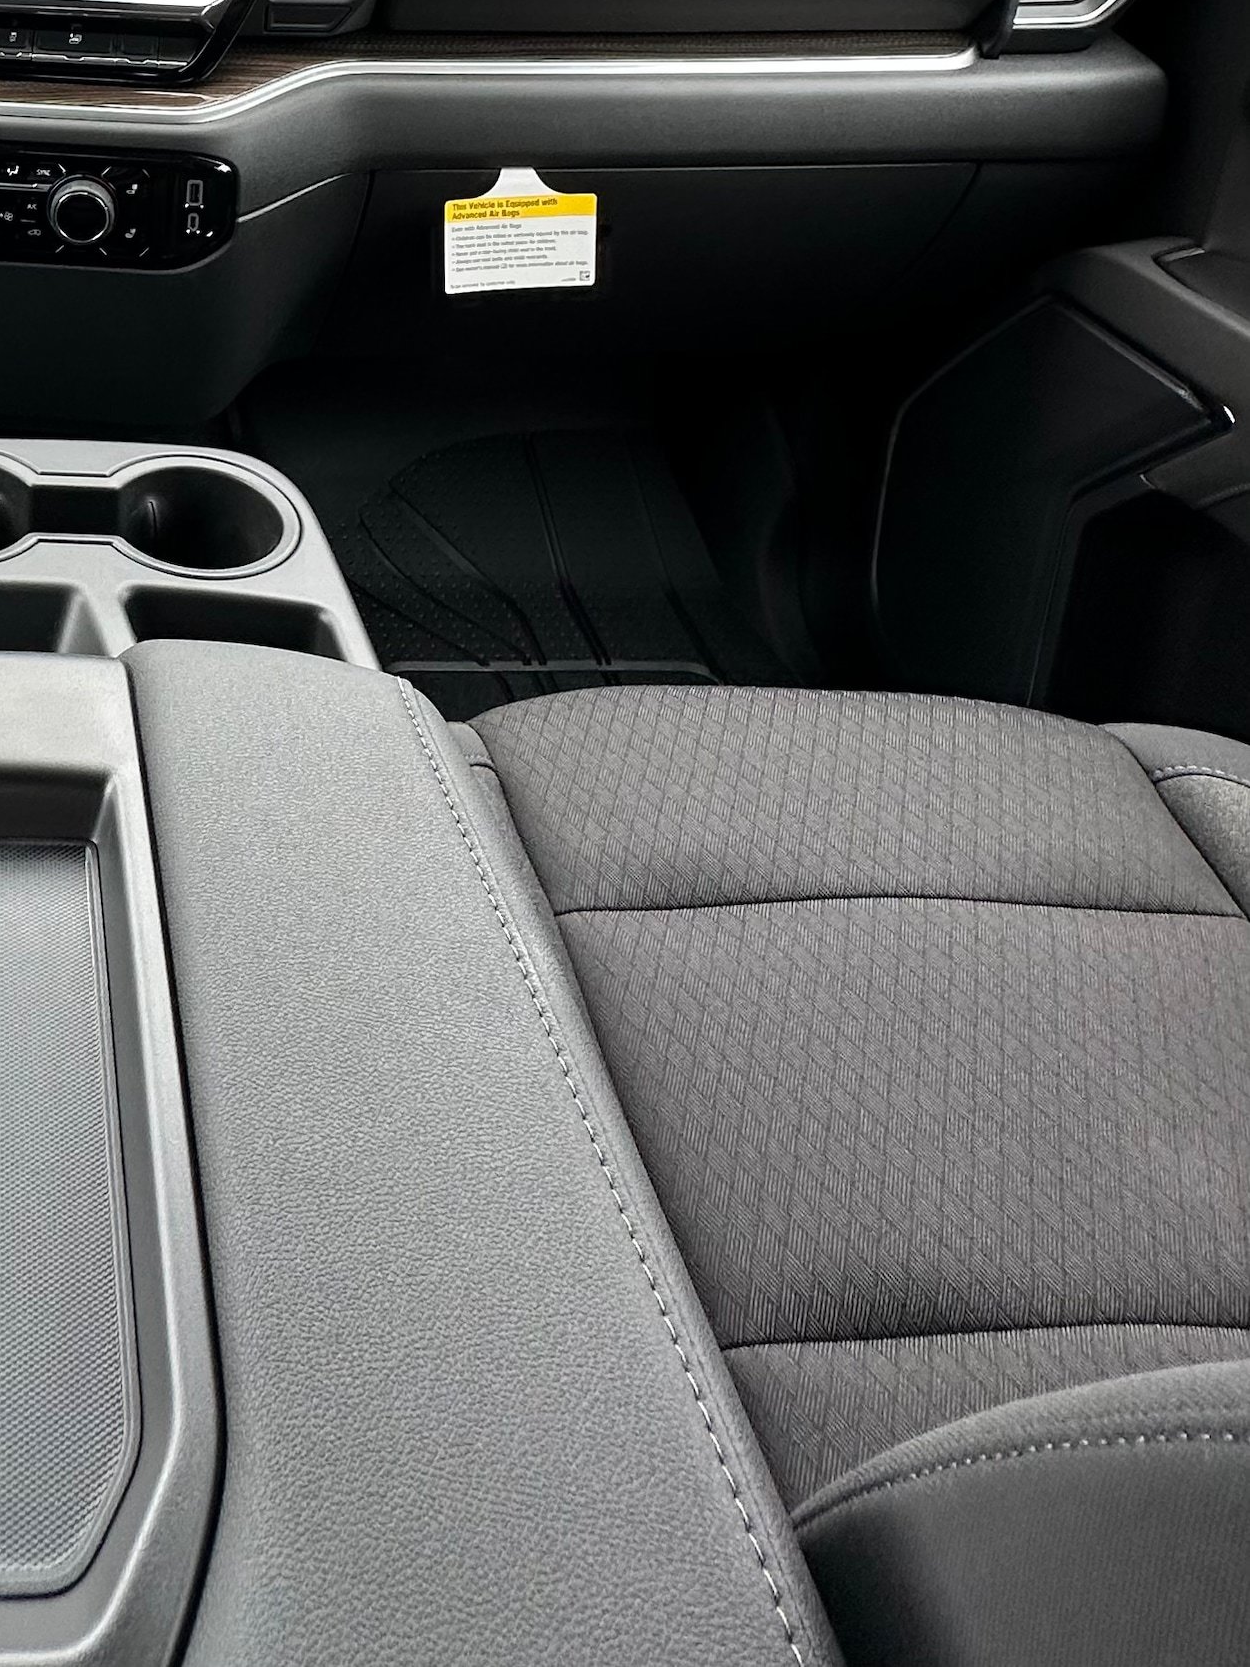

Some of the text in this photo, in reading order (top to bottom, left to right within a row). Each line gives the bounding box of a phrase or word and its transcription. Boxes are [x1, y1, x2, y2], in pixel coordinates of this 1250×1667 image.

[452, 203, 467, 212] This
[469, 201, 495, 210] Vehicle
[505, 199, 540, 210] Equipped
[541, 198, 558, 207] with
[452, 208, 520, 221] Advanced Air Bags
